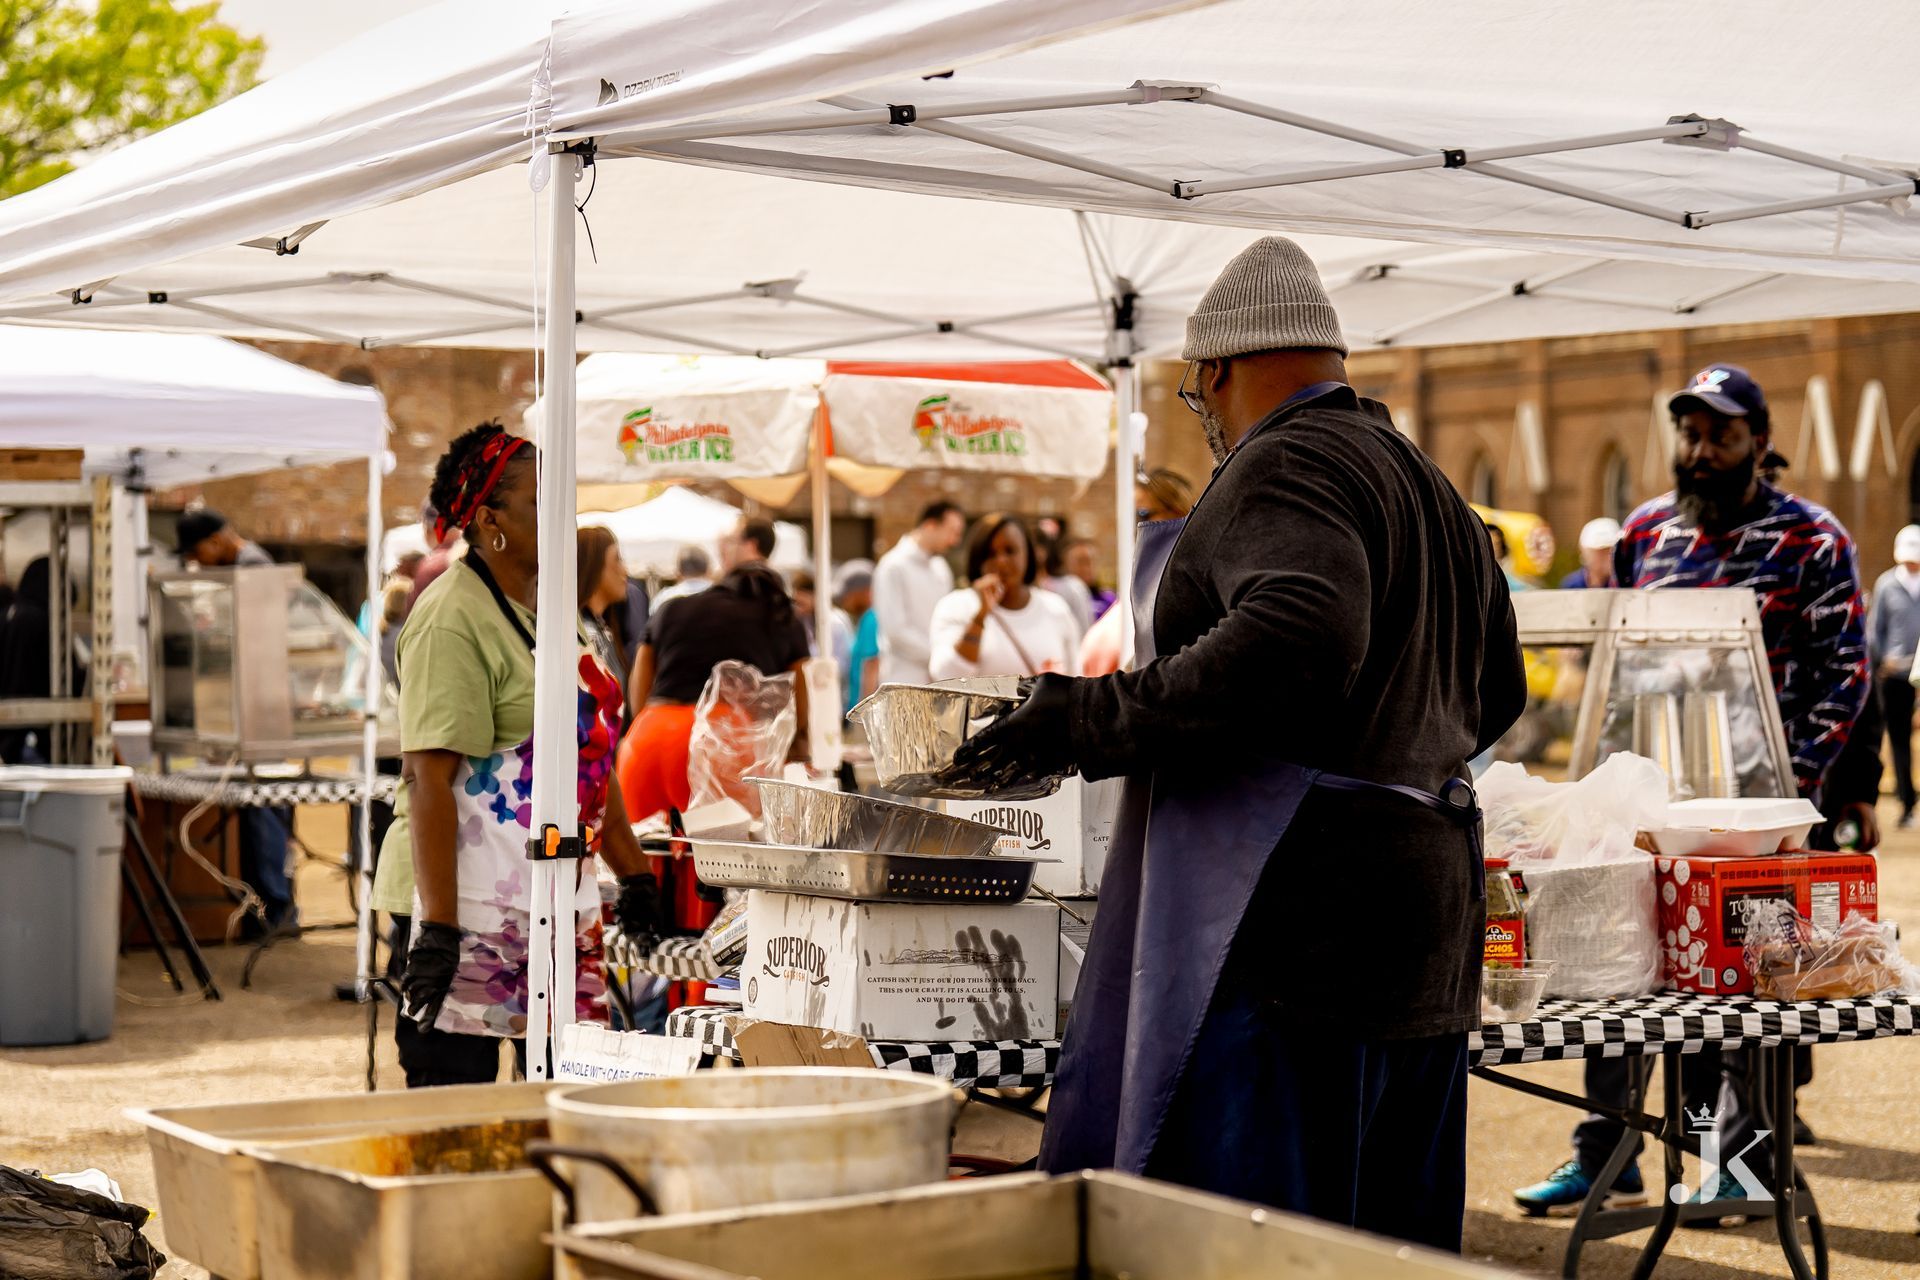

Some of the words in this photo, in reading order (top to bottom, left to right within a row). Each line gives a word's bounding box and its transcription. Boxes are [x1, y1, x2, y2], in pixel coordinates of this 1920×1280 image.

[767, 936, 826, 978] SUPERIOR
[898, 976, 918, 984] ISN'T
[560, 1060, 589, 1077] HANDLE
